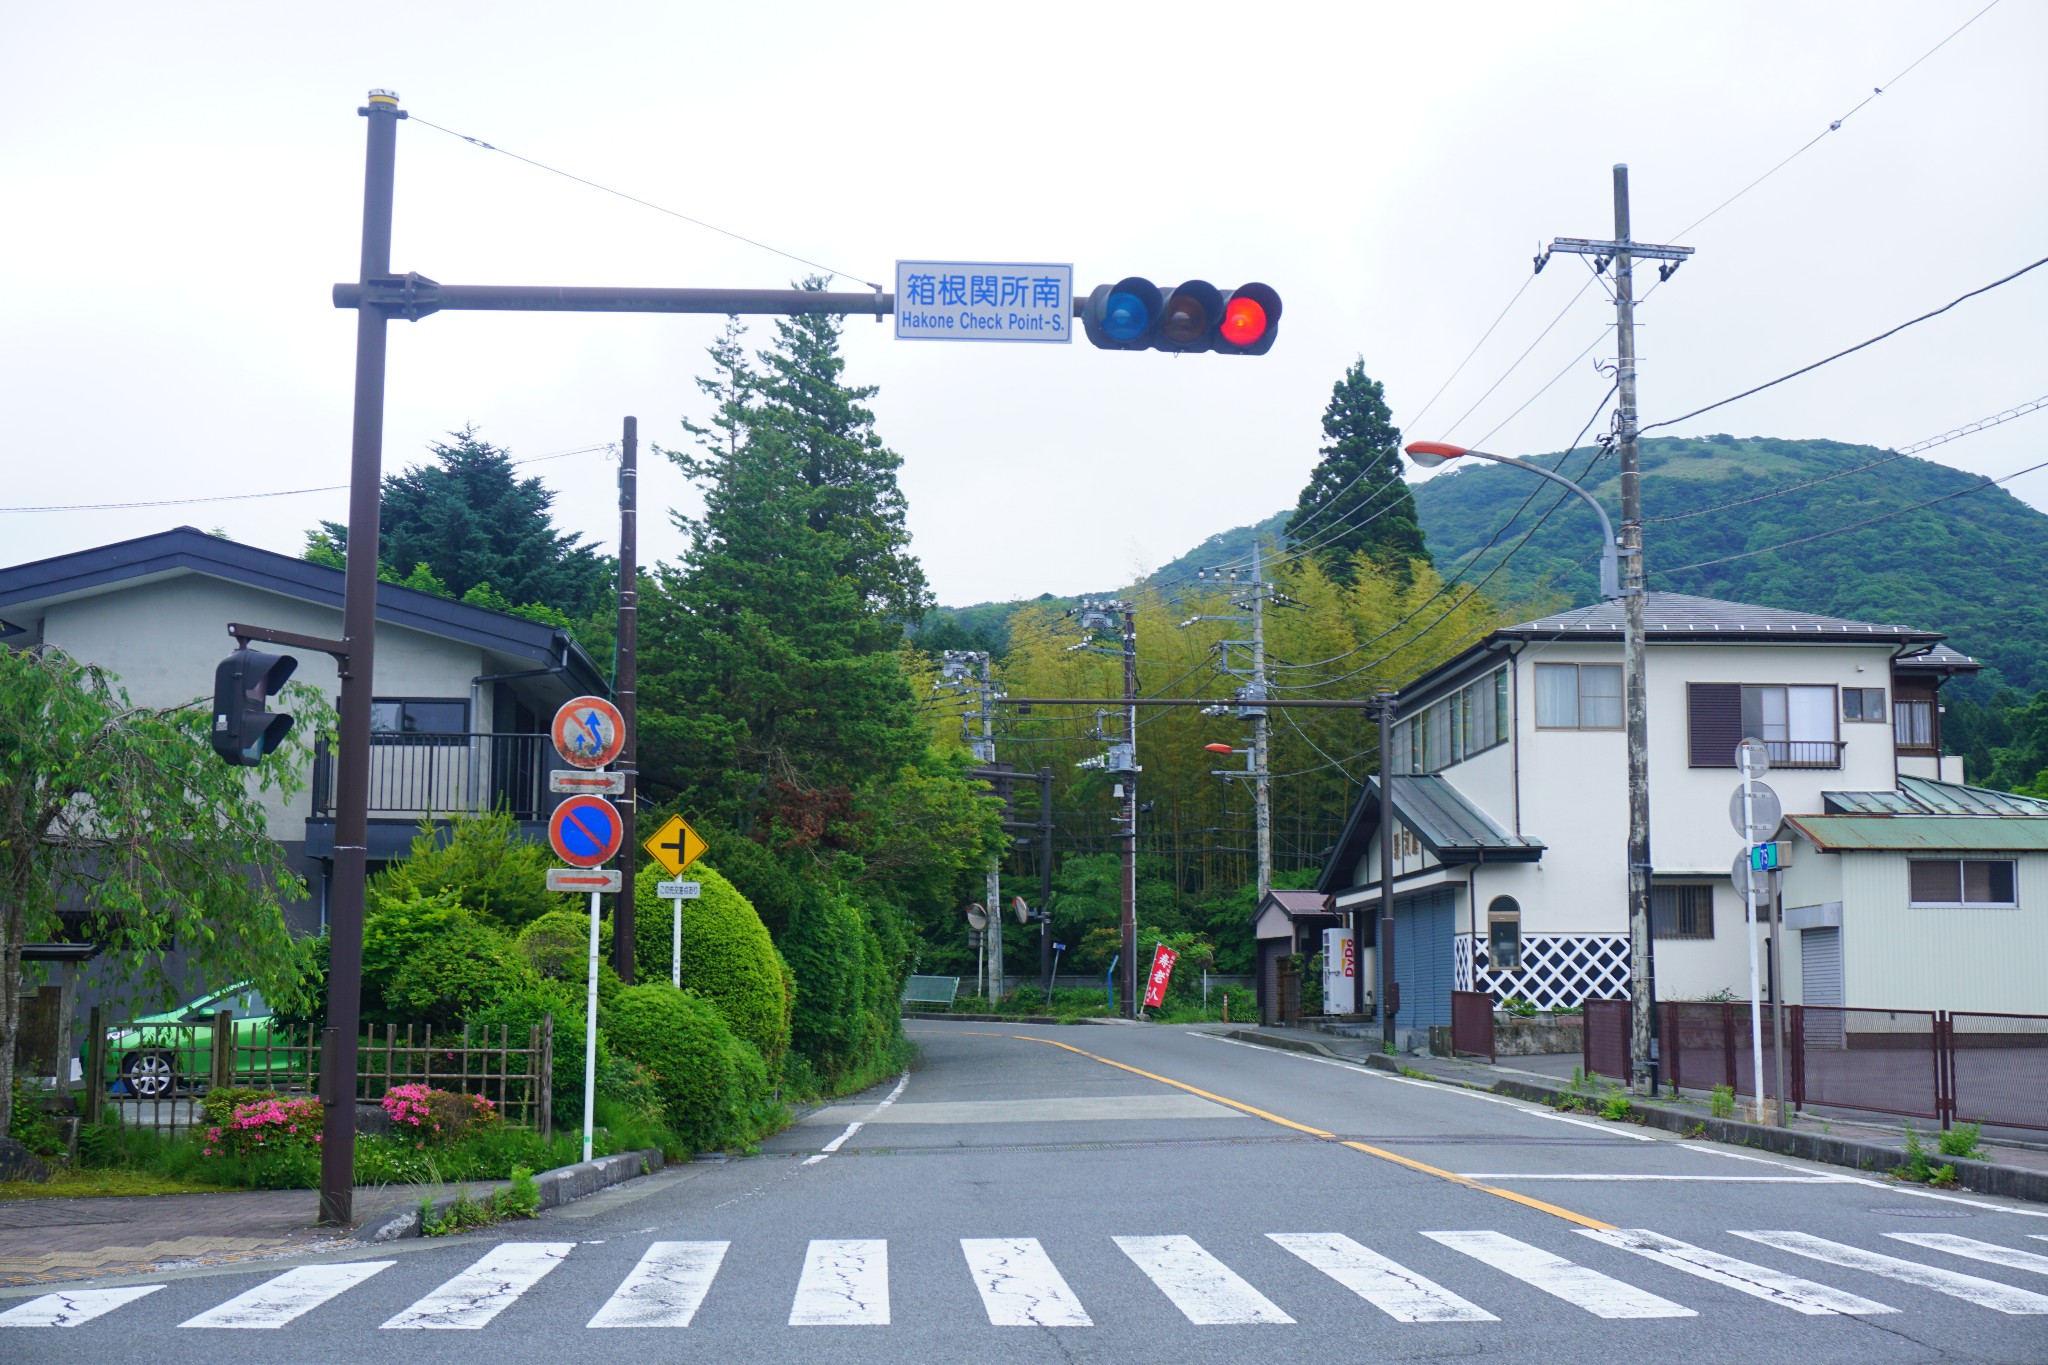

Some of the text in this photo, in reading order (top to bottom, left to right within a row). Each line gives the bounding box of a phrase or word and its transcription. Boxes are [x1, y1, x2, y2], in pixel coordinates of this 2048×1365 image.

[906, 273, 1062, 308] 箱根関所南
[902, 311, 1065, 331] Hakone Check Point-S.
[659, 885, 699, 895] この先交差点あり
[1344, 938, 1356, 977] DyDo
[1150, 953, 1170, 1000] 寿老人
